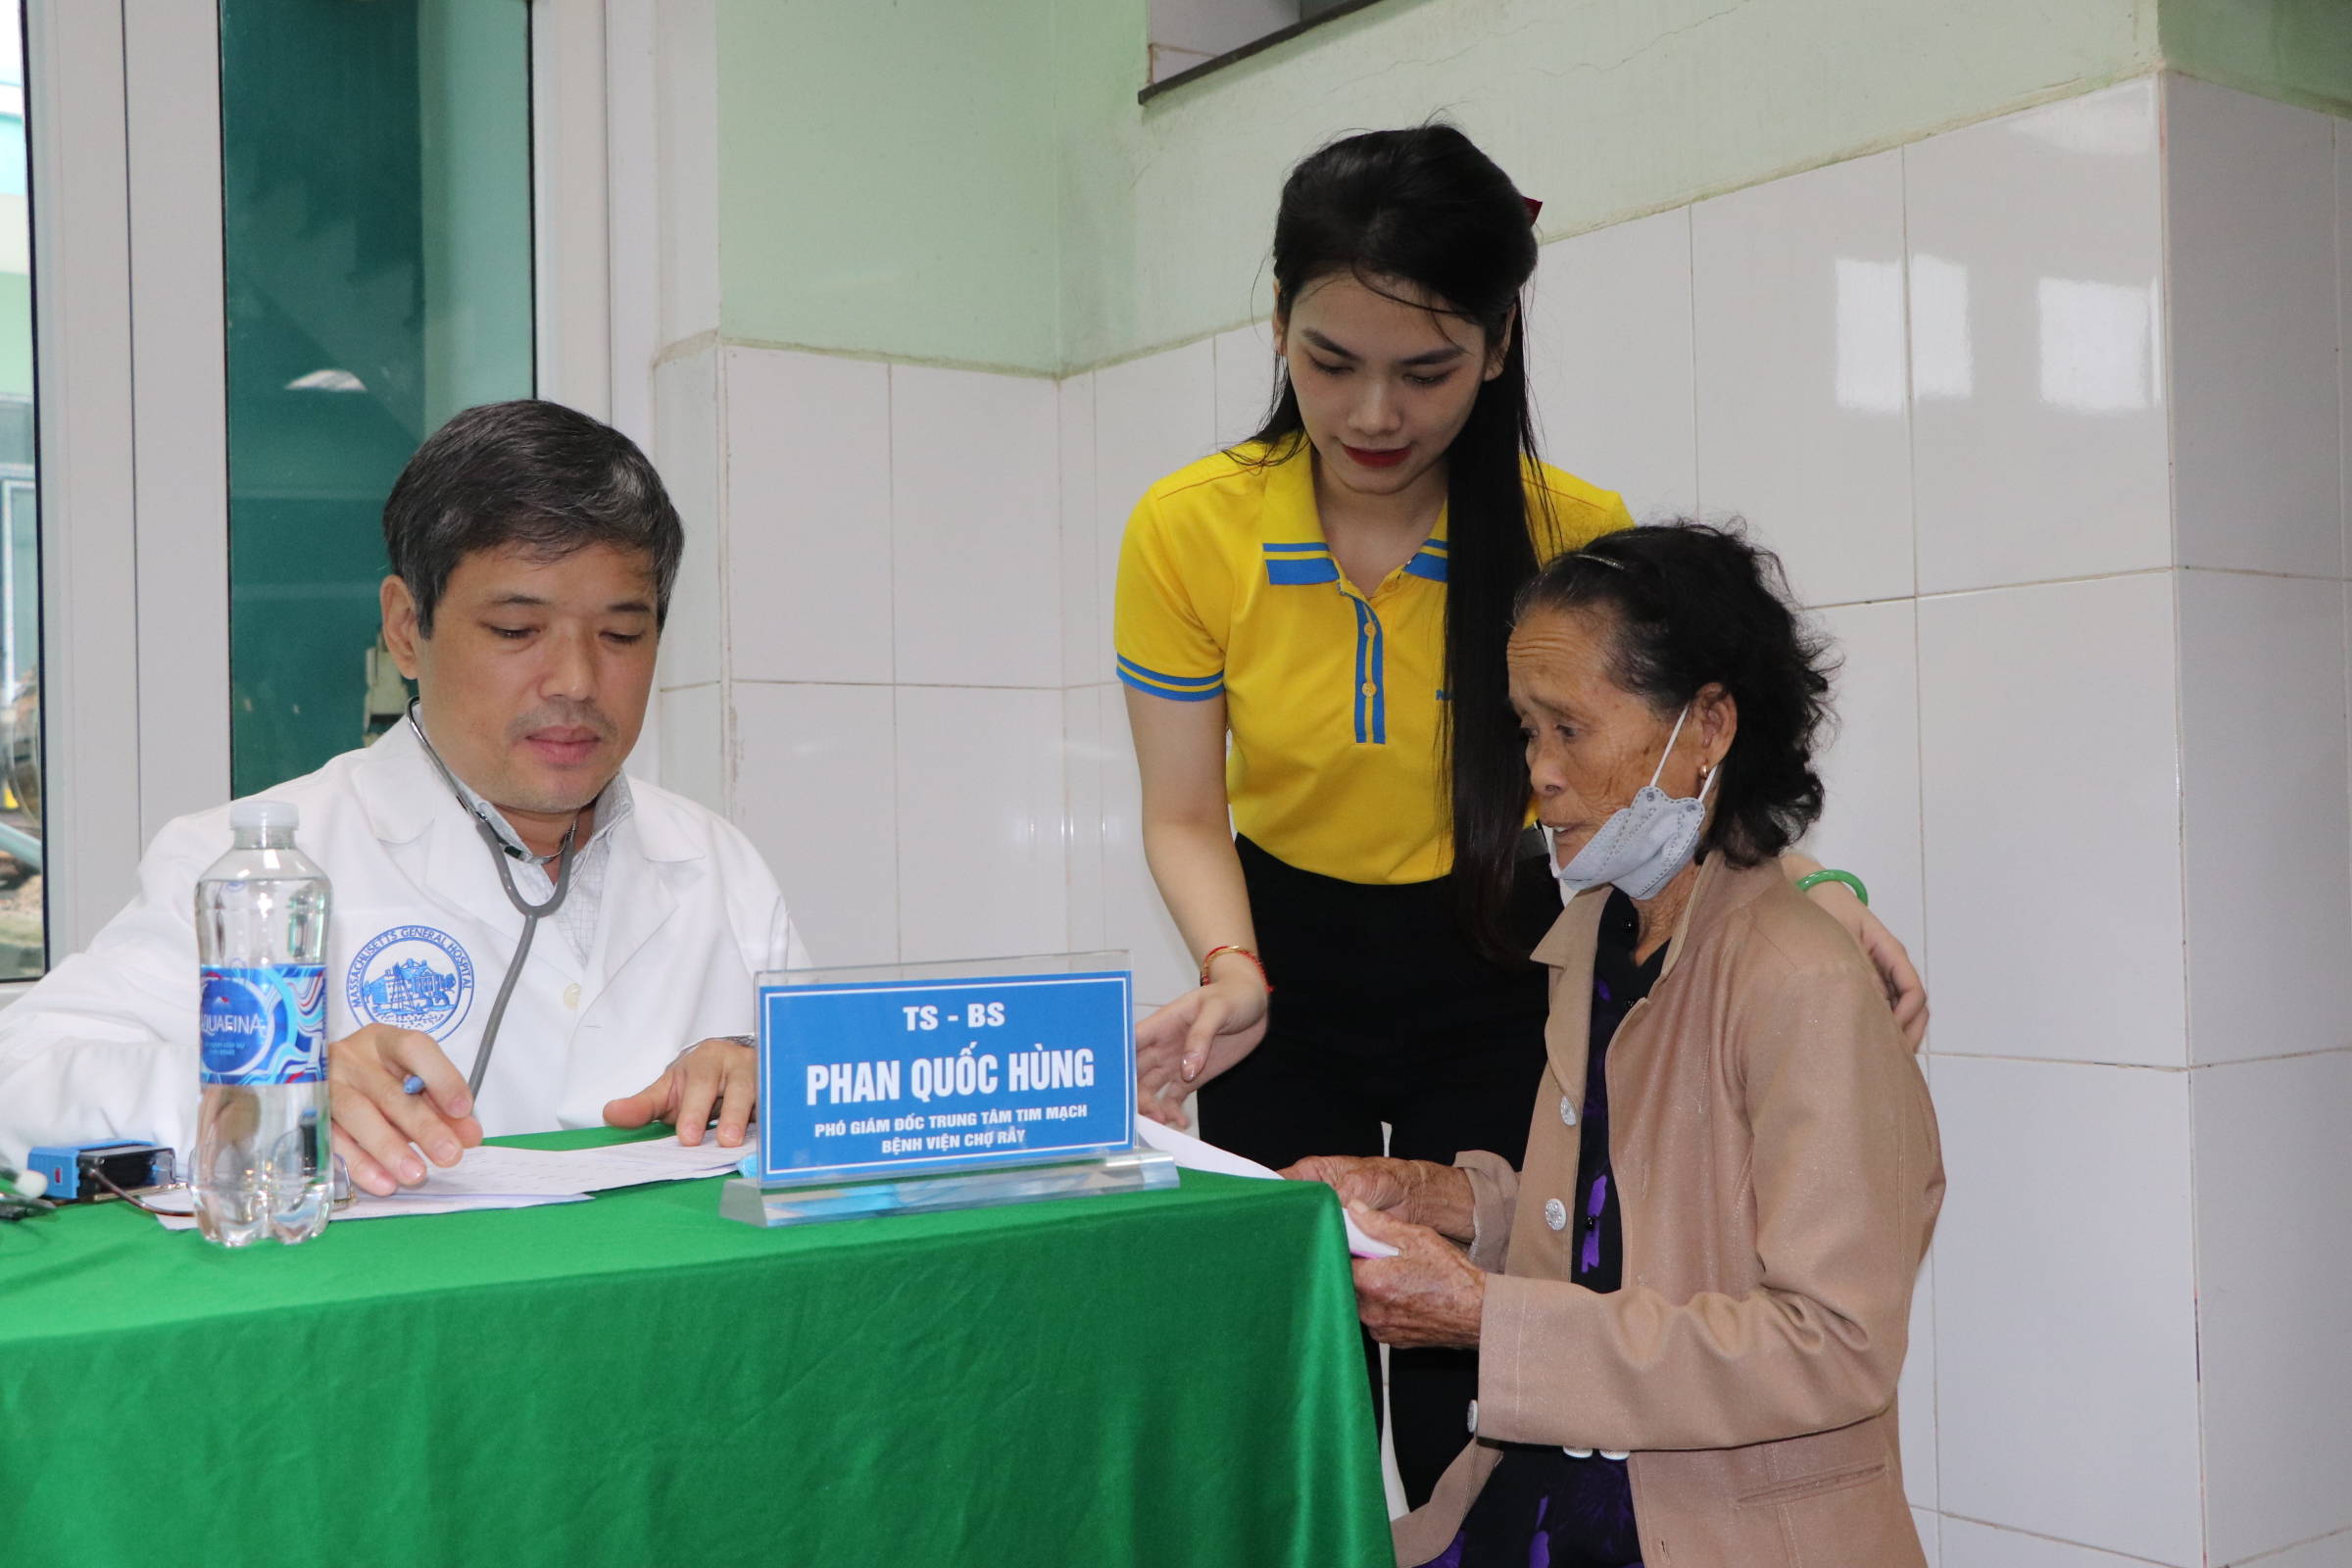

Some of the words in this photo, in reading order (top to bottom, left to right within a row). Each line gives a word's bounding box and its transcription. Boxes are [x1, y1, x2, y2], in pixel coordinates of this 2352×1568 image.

[349, 930, 398, 1008] MASSACHUSETTS
[401, 928, 447, 948] GENERAL
[447, 942, 473, 991] HOSPITAL
[200, 1013, 266, 1037] QUAFINA
[903, 1005, 938, 1031] TS
[968, 1003, 1004, 1027] BS
[807, 1060, 900, 1105] PHAN
[911, 1041, 998, 1102] QUỐC
[1008, 1043, 1095, 1092] HÙNG
[814, 1119, 846, 1138] PHÓ
[851, 1117, 890, 1135] GIÁM
[894, 1112, 925, 1131] ĐỐC
[928, 1112, 977, 1129] TRUNG
[981, 1108, 1012, 1124] TÂM
[1015, 1107, 1042, 1122] TIM
[1046, 1104, 1087, 1121] MẠCH
[882, 1137, 922, 1155] BỆNH
[926, 1133, 960, 1152] VIỆN
[964, 1130, 994, 1148] CHỢ
